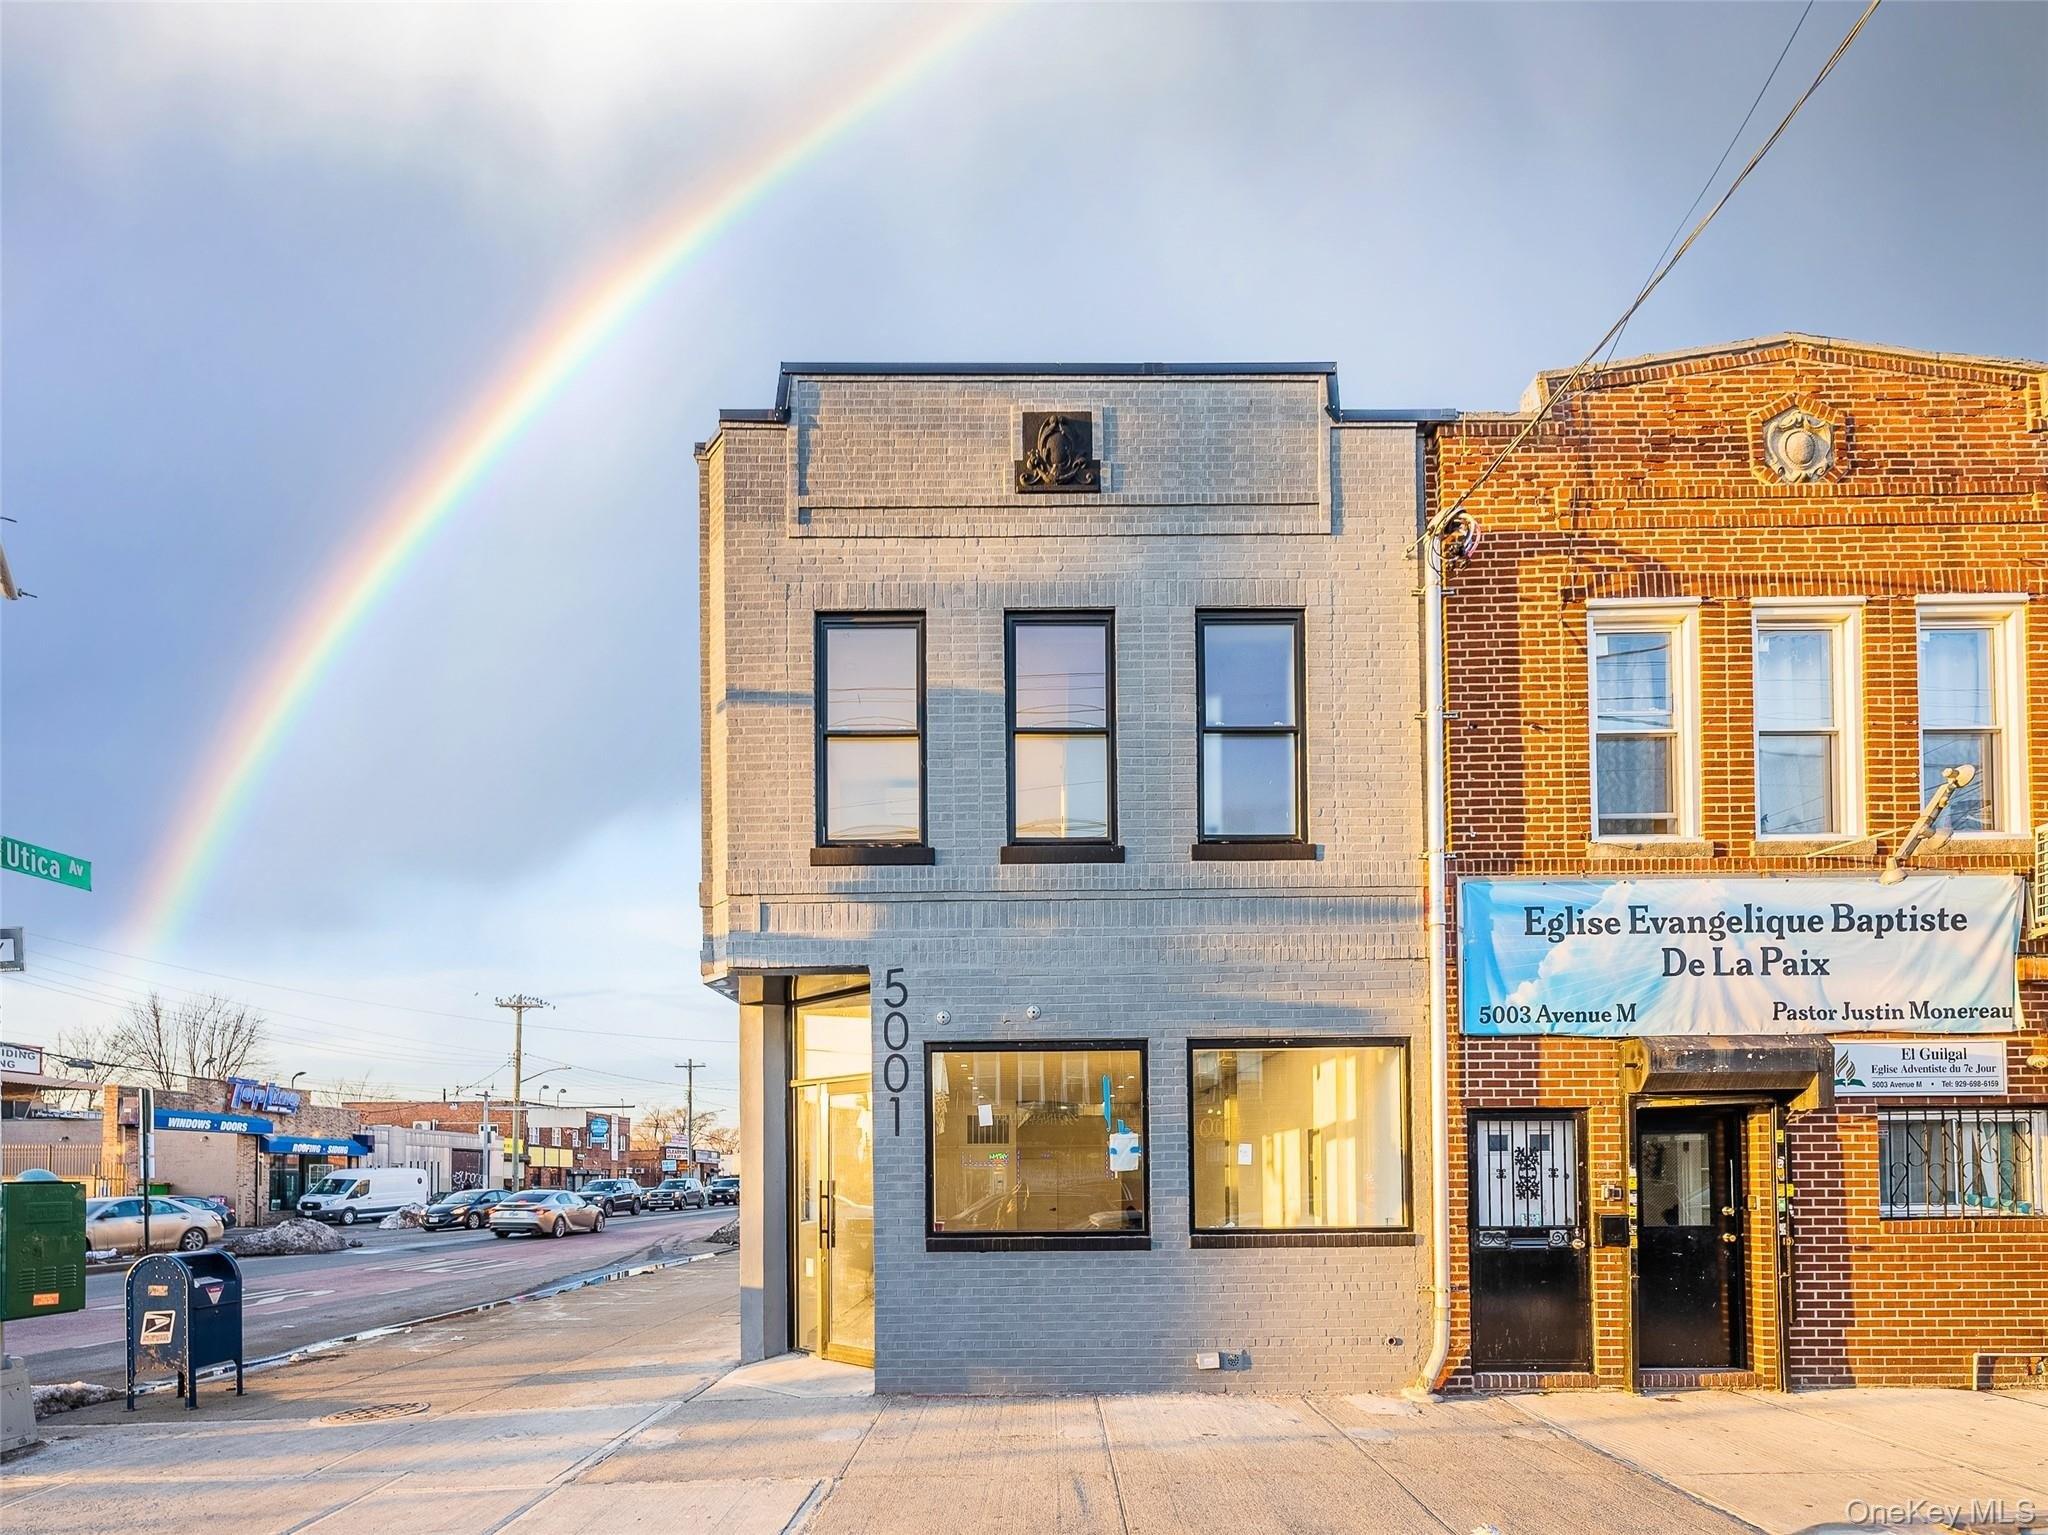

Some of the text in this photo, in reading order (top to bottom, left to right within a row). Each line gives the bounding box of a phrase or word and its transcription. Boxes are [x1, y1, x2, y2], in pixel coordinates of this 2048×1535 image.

[6, 841, 84, 879] Utica Av
[1524, 903, 1968, 943] Eglise Evangelique Baptiste
[1661, 946, 1830, 977] De La Paix
[1479, 1003, 1637, 1024] 5003 Avenue M
[1772, 1000, 2014, 1021] Pastor Justin Monereau
[883, 967, 909, 1137] 5001
[1901, 1047, 1967, 1063] El Guilgal
[1871, 1064, 1997, 1076] Eglise Adventiste du 7e Jour
[168, 1117, 248, 1132] WINDOWS DOORS
[292, 1143, 349, 1154] ROOFING SIDING
